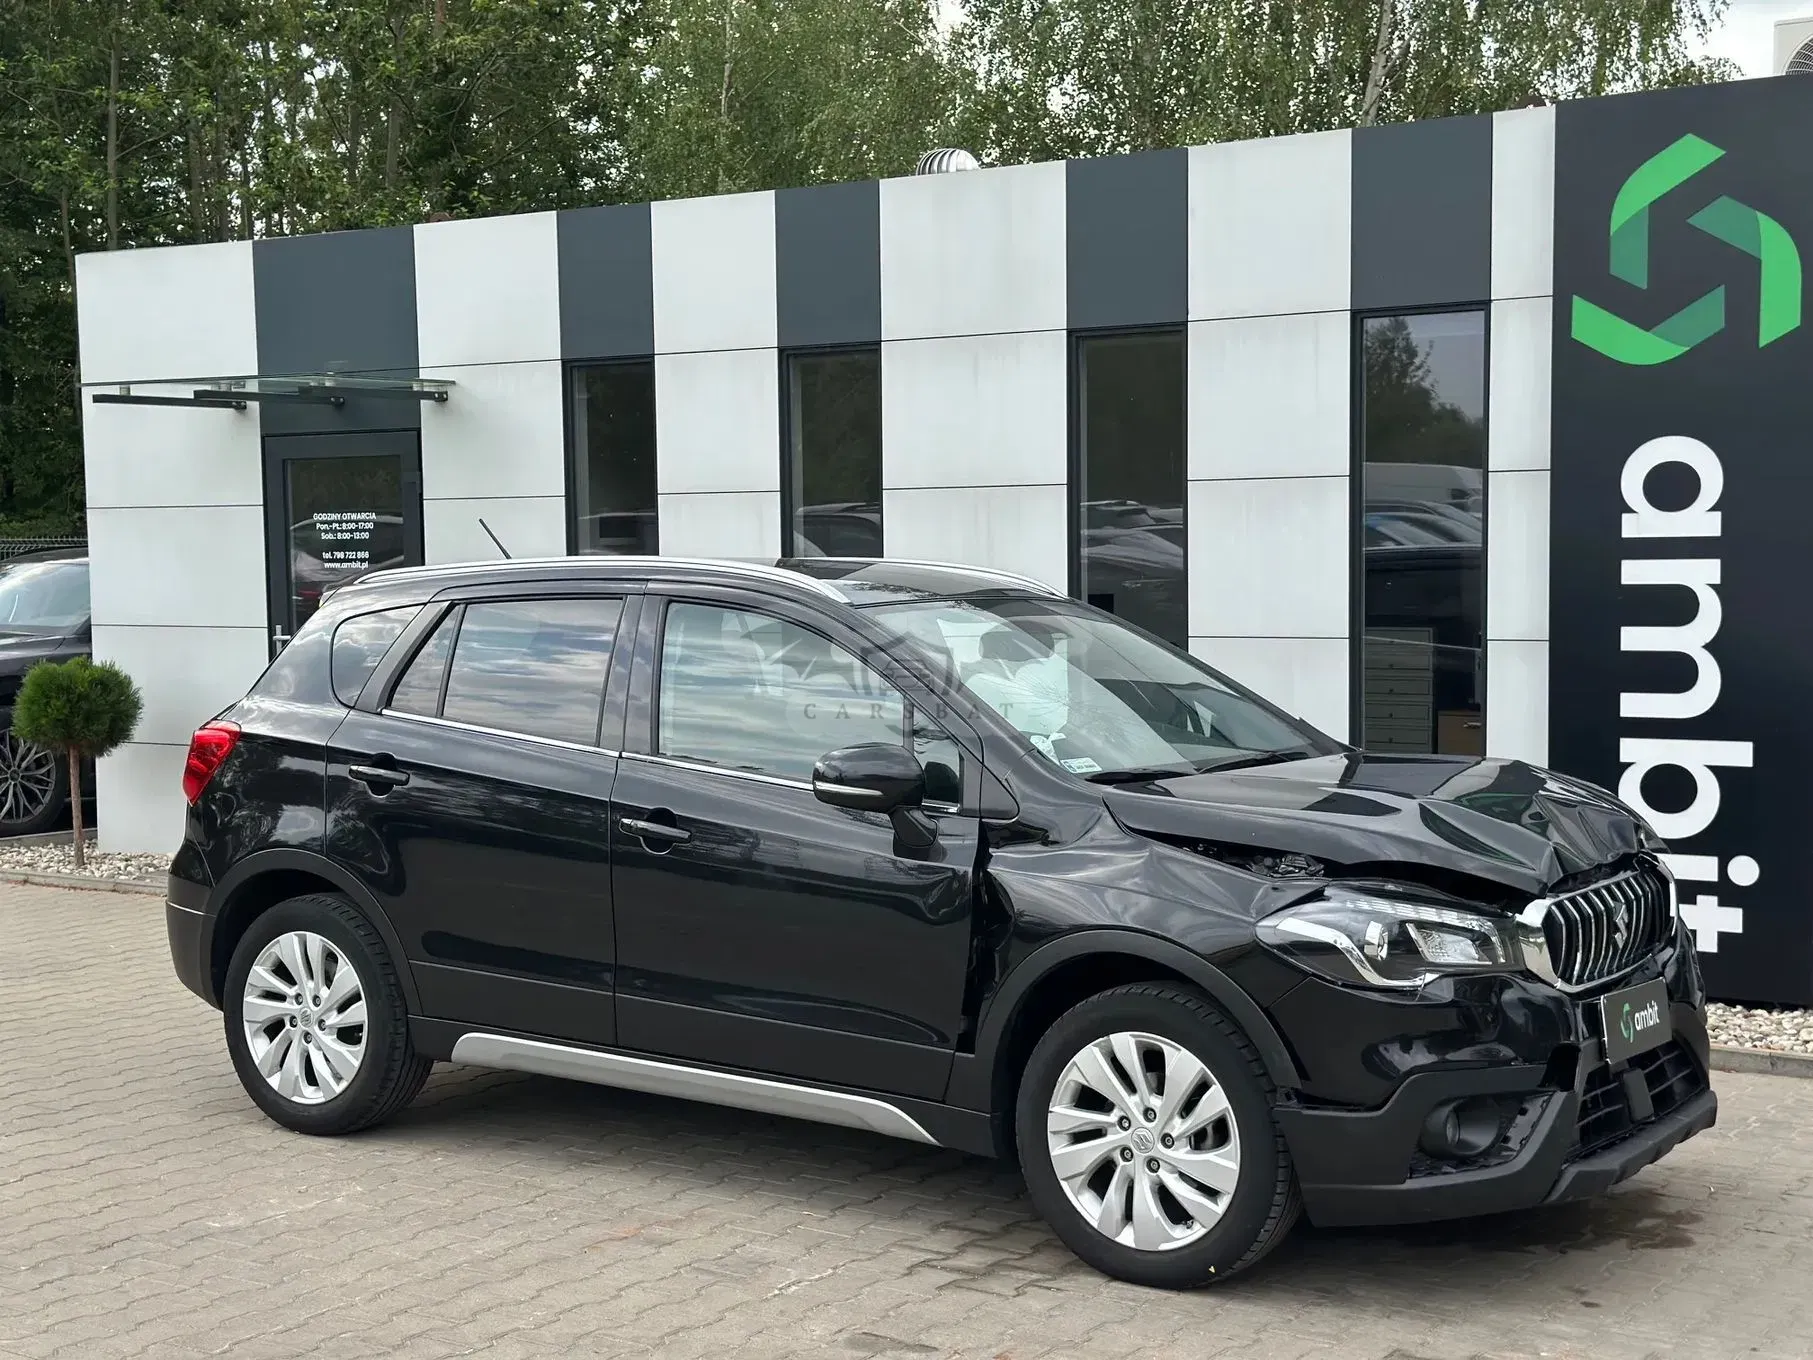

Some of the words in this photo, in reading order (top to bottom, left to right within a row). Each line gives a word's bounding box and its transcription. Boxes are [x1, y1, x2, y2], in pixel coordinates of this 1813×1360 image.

[342, 512, 377, 520] OTWARCIA
[342, 522, 374, 530] 8:00-17:00
[337, 532, 369, 540] 8:00-13:00
[324, 561, 368, 570] www.ambit.pl
[1618, 435, 1760, 953] ambit
[1634, 1000, 1660, 1031] ambit
